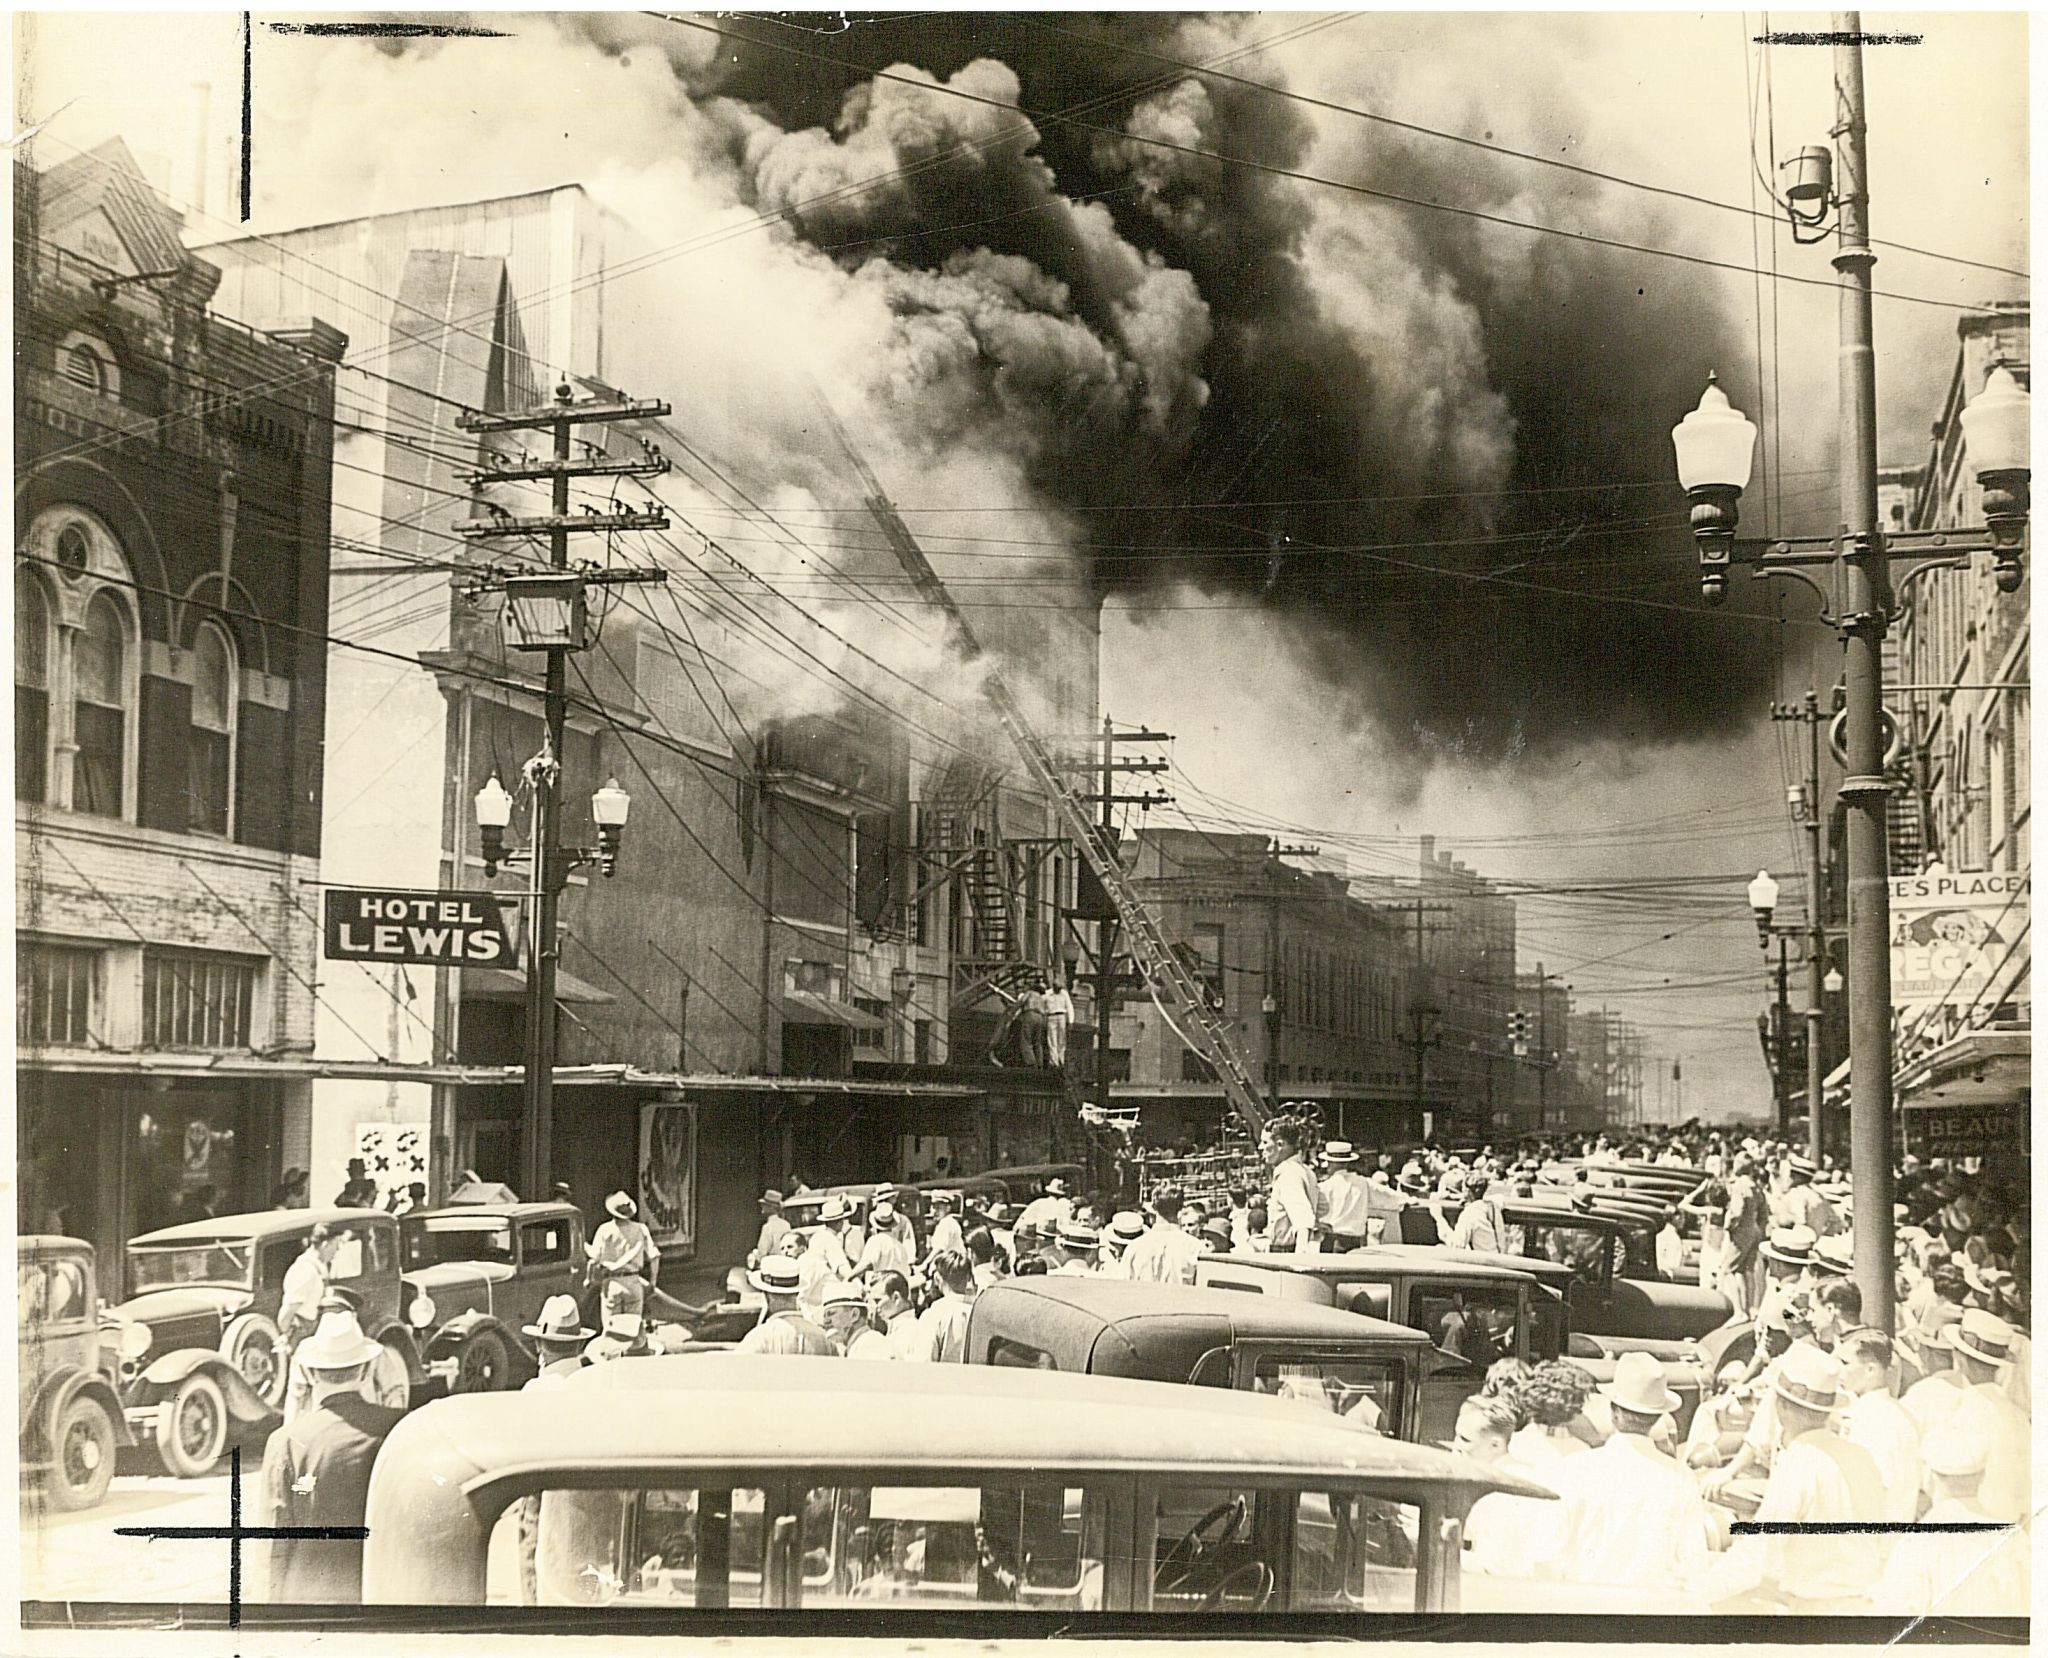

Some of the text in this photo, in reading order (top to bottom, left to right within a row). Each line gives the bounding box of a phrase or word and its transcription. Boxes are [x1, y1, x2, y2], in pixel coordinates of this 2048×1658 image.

[1889, 879, 1929, 897] E'S
[1938, 876, 2020, 895] PLACE
[360, 898, 483, 924] HOTEL
[339, 923, 501, 960] LEWIS
